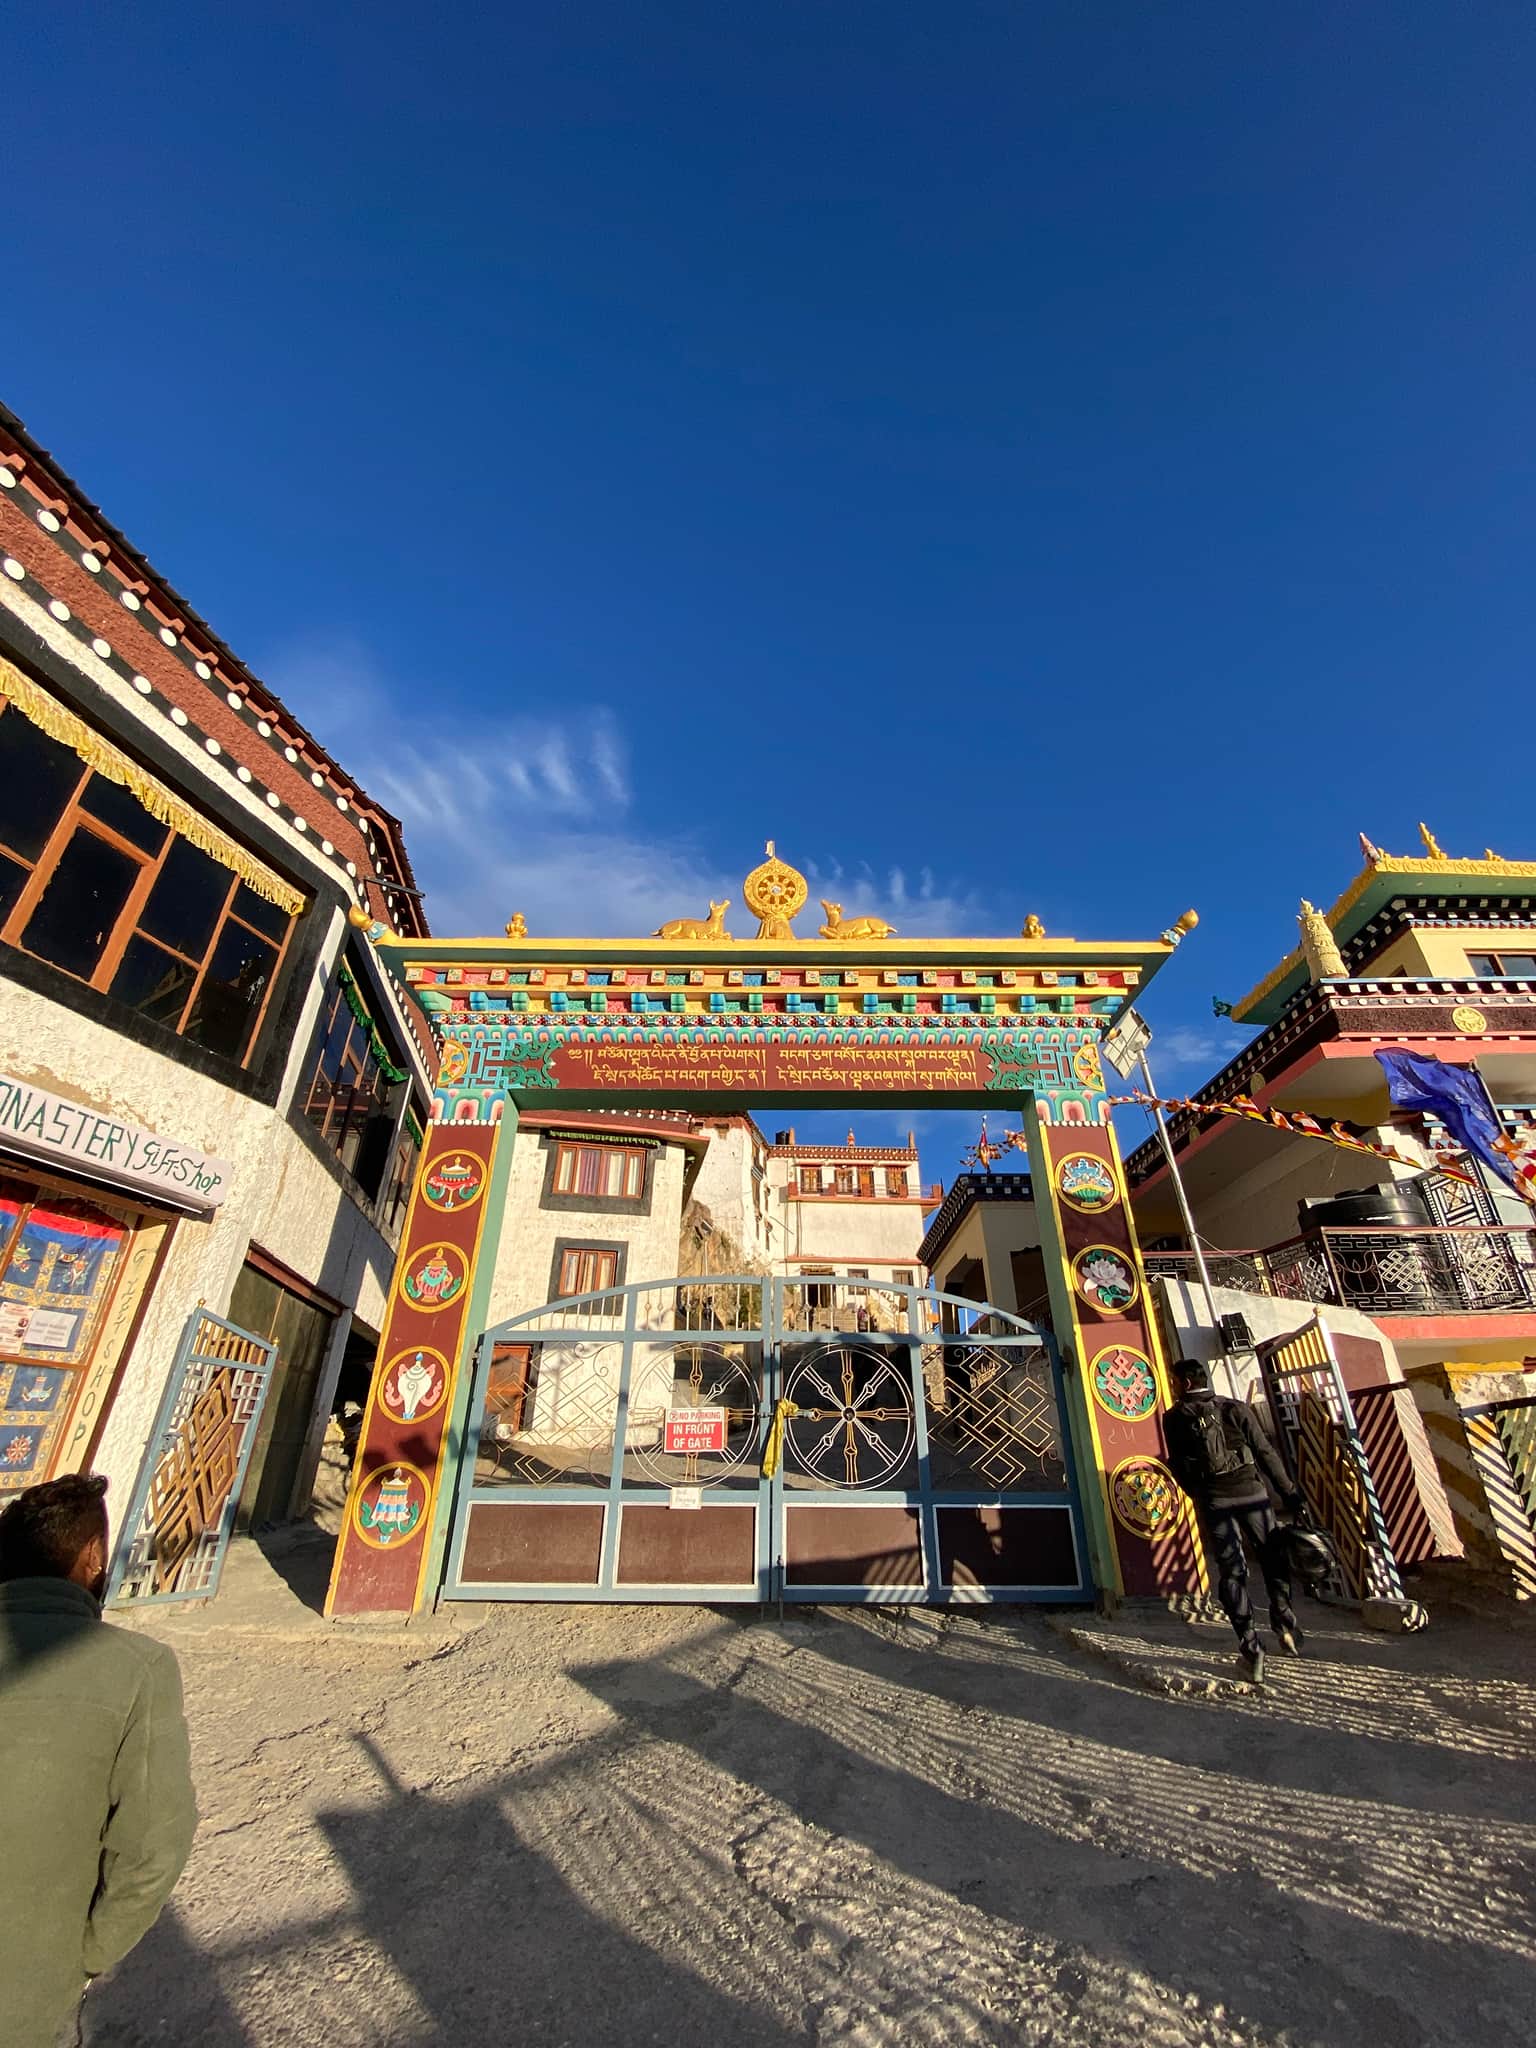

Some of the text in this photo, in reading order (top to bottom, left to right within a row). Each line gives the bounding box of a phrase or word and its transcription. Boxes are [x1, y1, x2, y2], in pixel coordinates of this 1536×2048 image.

[679, 1411, 721, 1420] NO PARKING
[673, 1423, 716, 1435] IN FRONT
[673, 1437, 712, 1449] OF GATE
